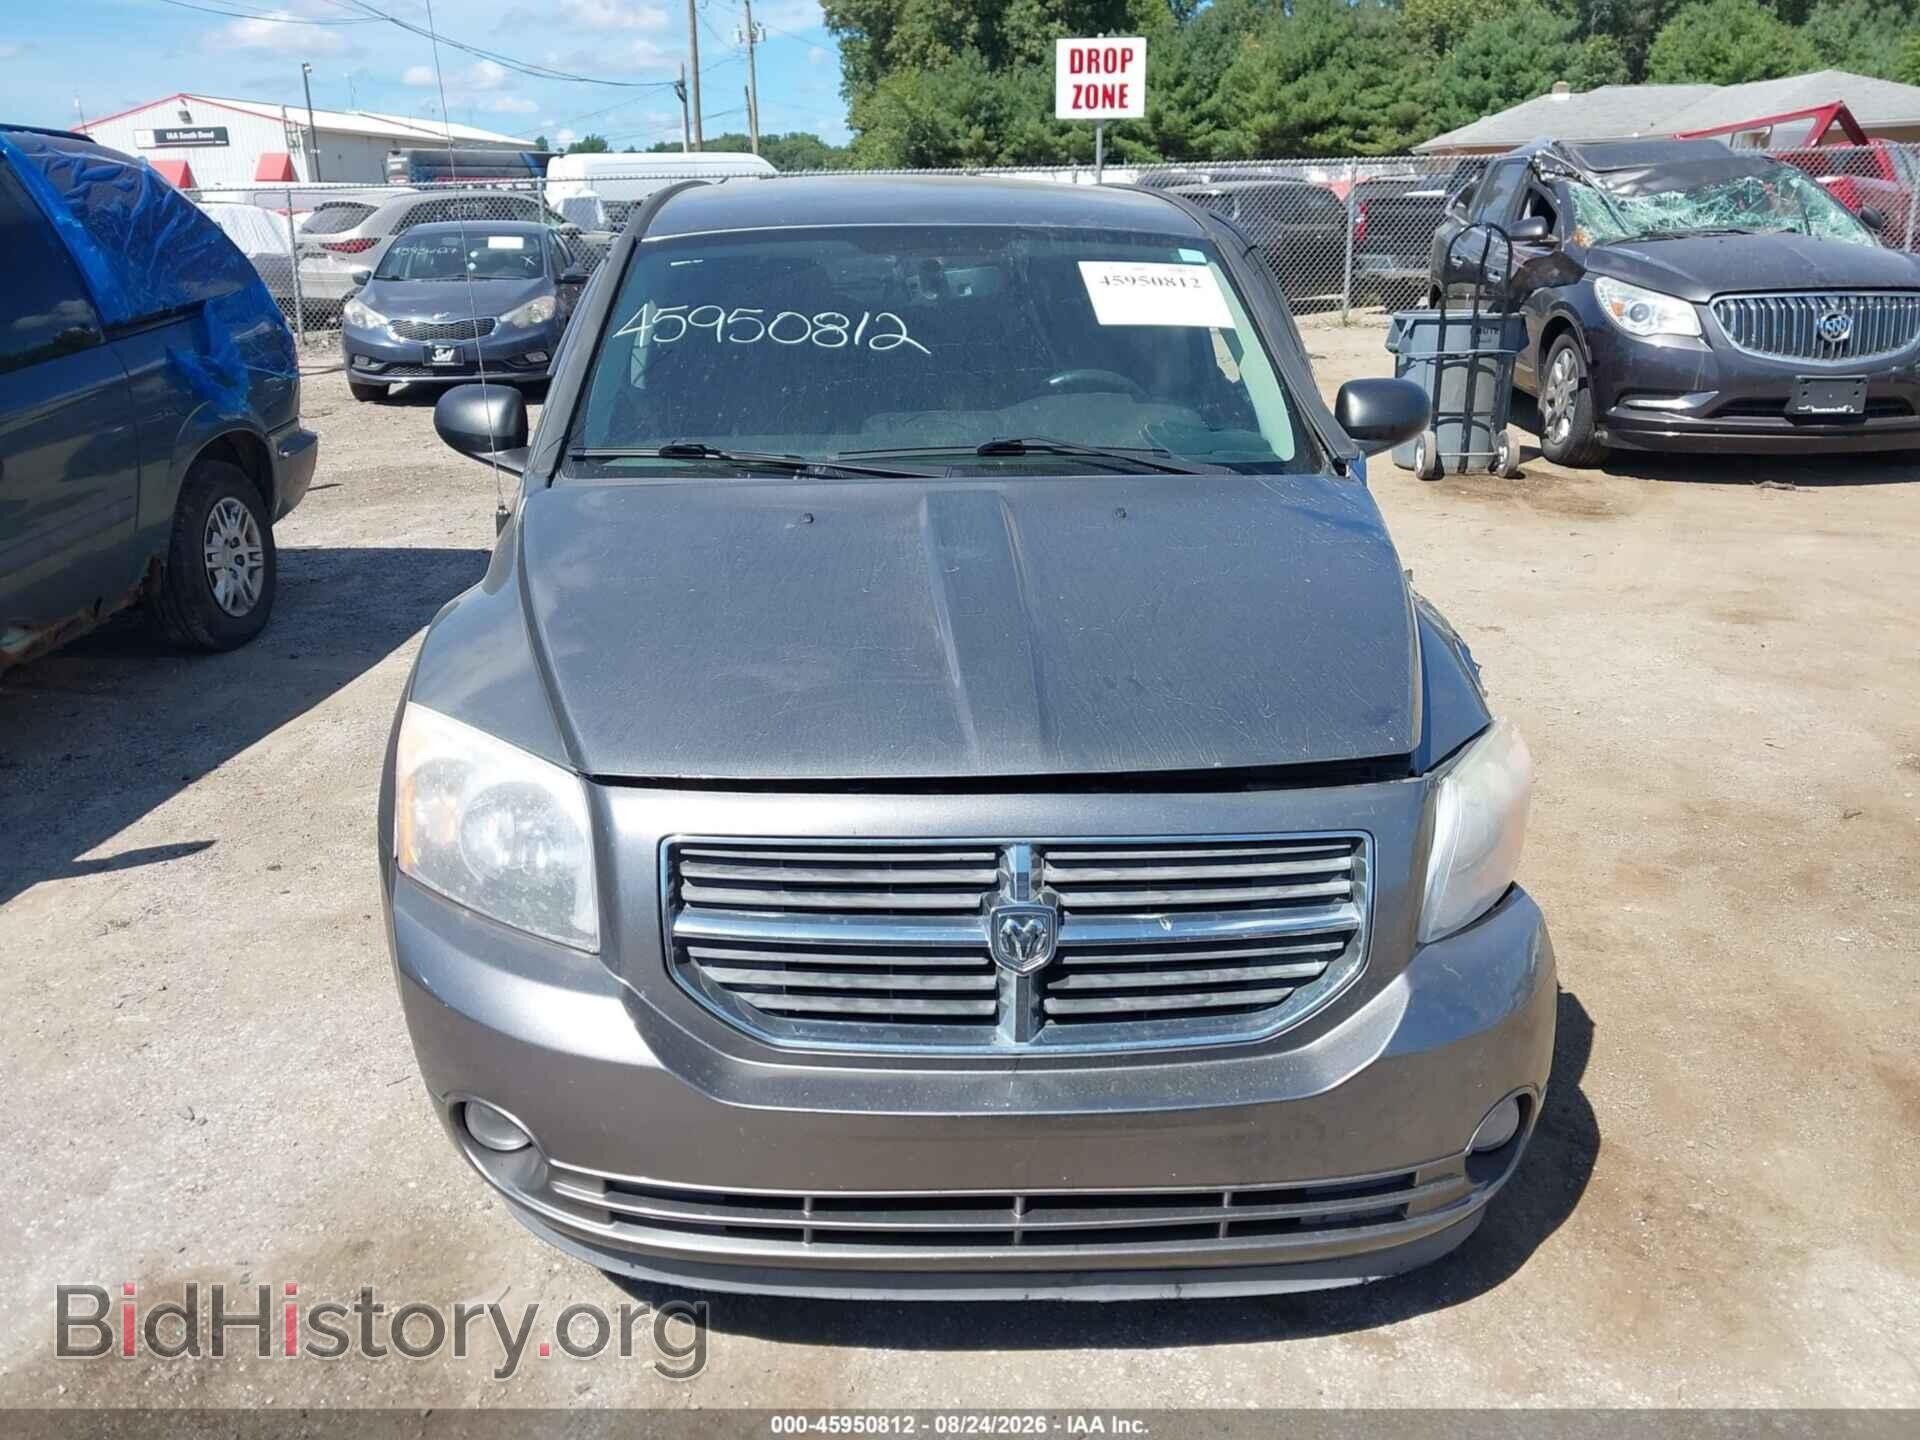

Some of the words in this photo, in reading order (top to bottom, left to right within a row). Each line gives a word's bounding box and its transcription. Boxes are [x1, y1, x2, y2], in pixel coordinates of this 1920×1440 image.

[1070, 47, 1133, 74] DROP
[1072, 84, 1128, 109] ZONE
[1099, 275, 1203, 288] 45950812
[612, 303, 931, 354] 45950812
